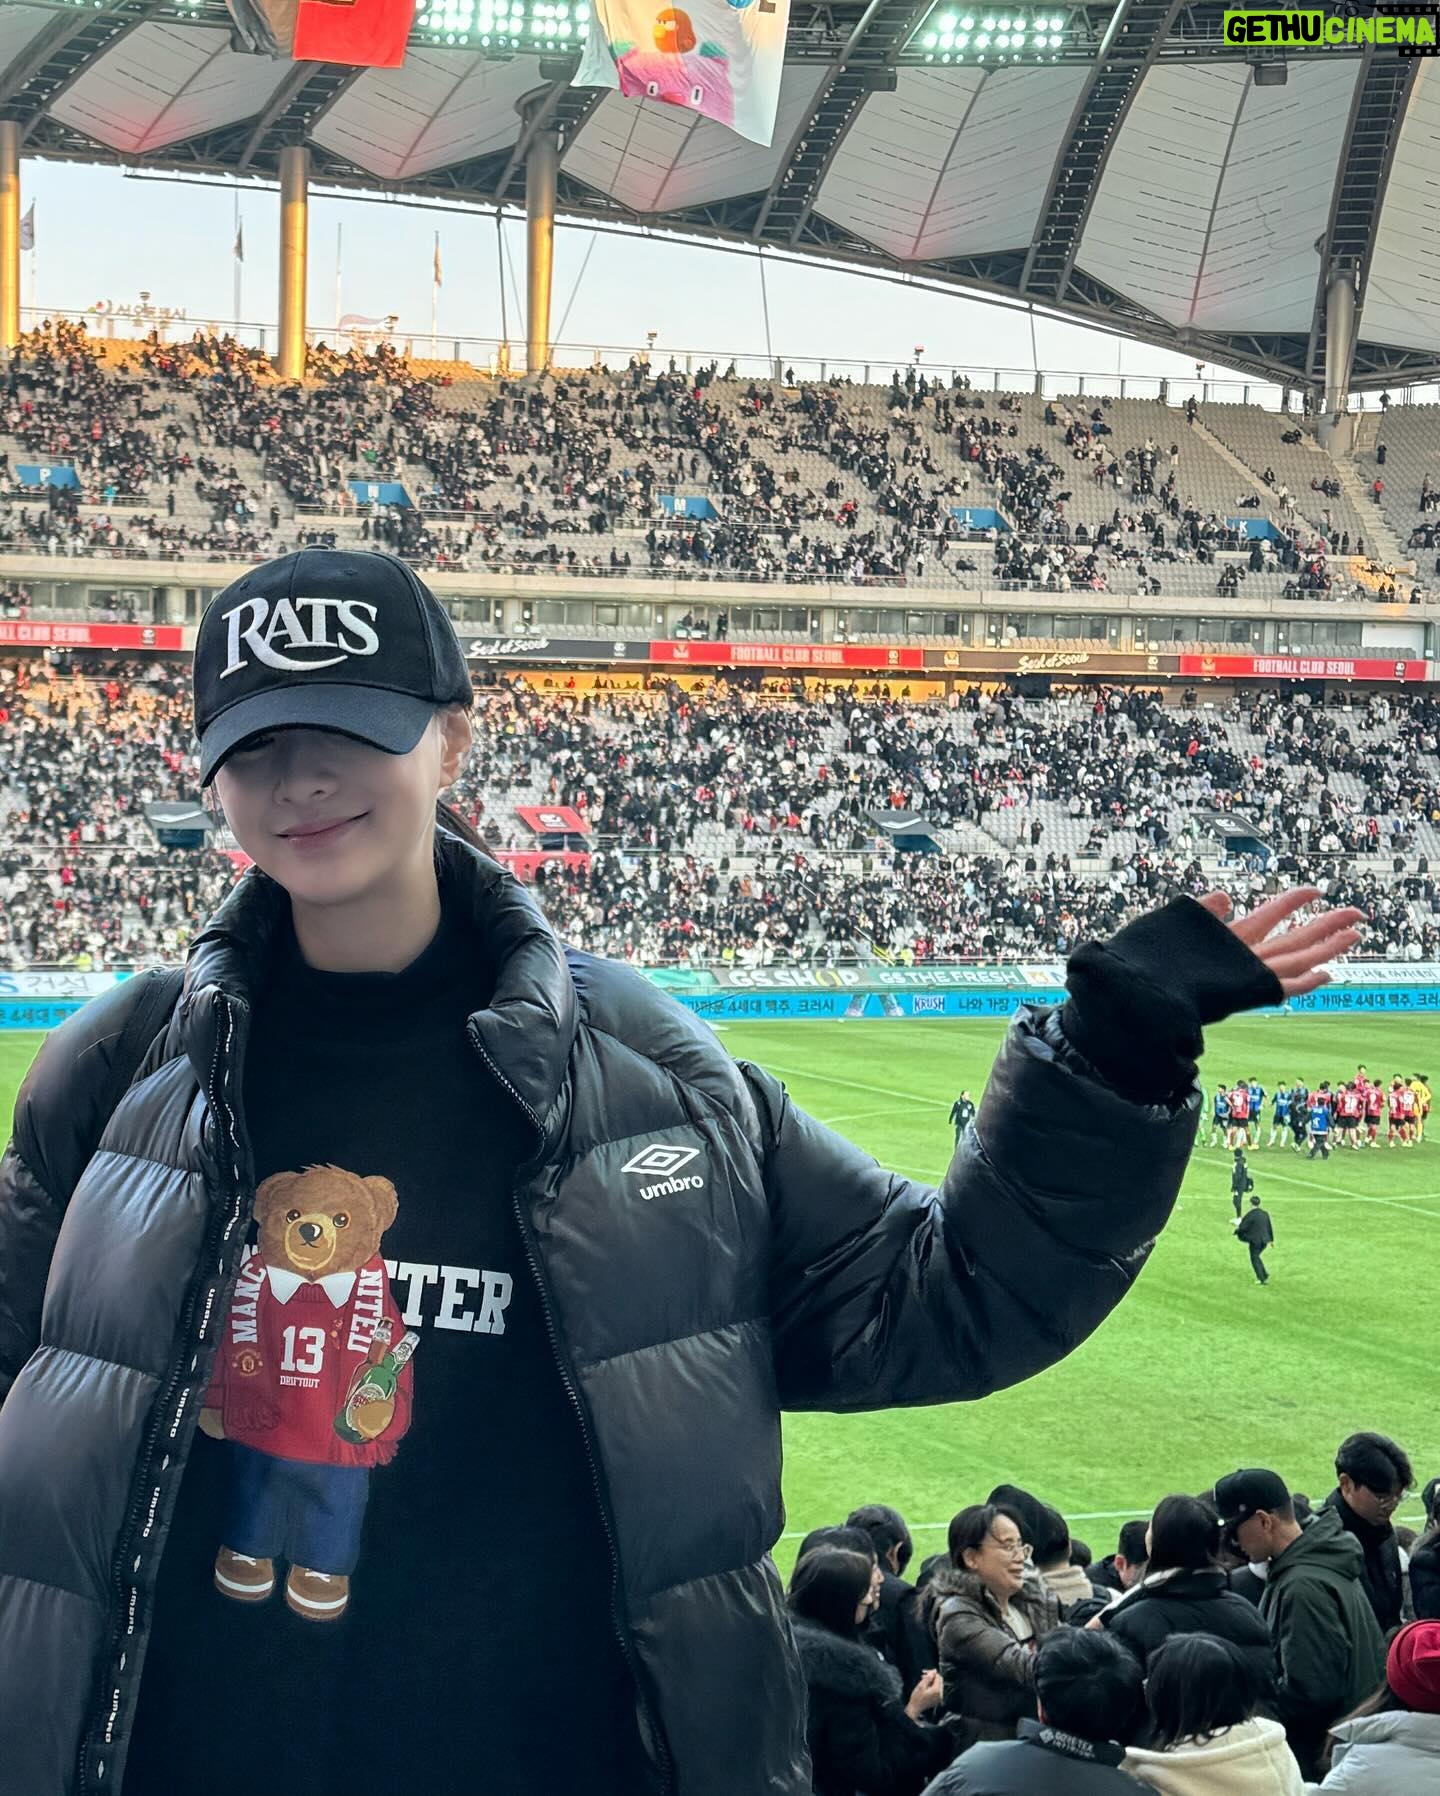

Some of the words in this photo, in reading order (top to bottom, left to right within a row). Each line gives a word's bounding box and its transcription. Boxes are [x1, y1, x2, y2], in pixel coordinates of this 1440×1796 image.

[1240, 520, 1247, 532] K
[219, 597, 380, 680] RATS
[731, 646, 781, 662] FOOTBALL
[782, 648, 809, 663] CLUB
[812, 648, 844, 664] SEOUL
[1253, 659, 1298, 674] FOOTBALL
[1300, 660, 1324, 675] CLUB
[1327, 661, 1356, 676] SEOUL
[729, 970, 767, 987] GS
[879, 972, 905, 984] GS
[908, 972, 951, 984] THE
[951, 971, 1019, 984] FRESH
[799, 999, 834, 1012] 크러시
[915, 996, 945, 1012] KRUSH
[959, 997, 983, 1012] 나와
[988, 997, 1009, 1012] 가장
[1356, 993, 1386, 1007] 4세대
[1417, 993, 1440, 1006] 크러
[640, 1175, 704, 1200] umbro
[232, 1263, 267, 1344] MANC
[280, 1326, 325, 1374] 13
[279, 1375, 320, 1389] DRIFTOUT
